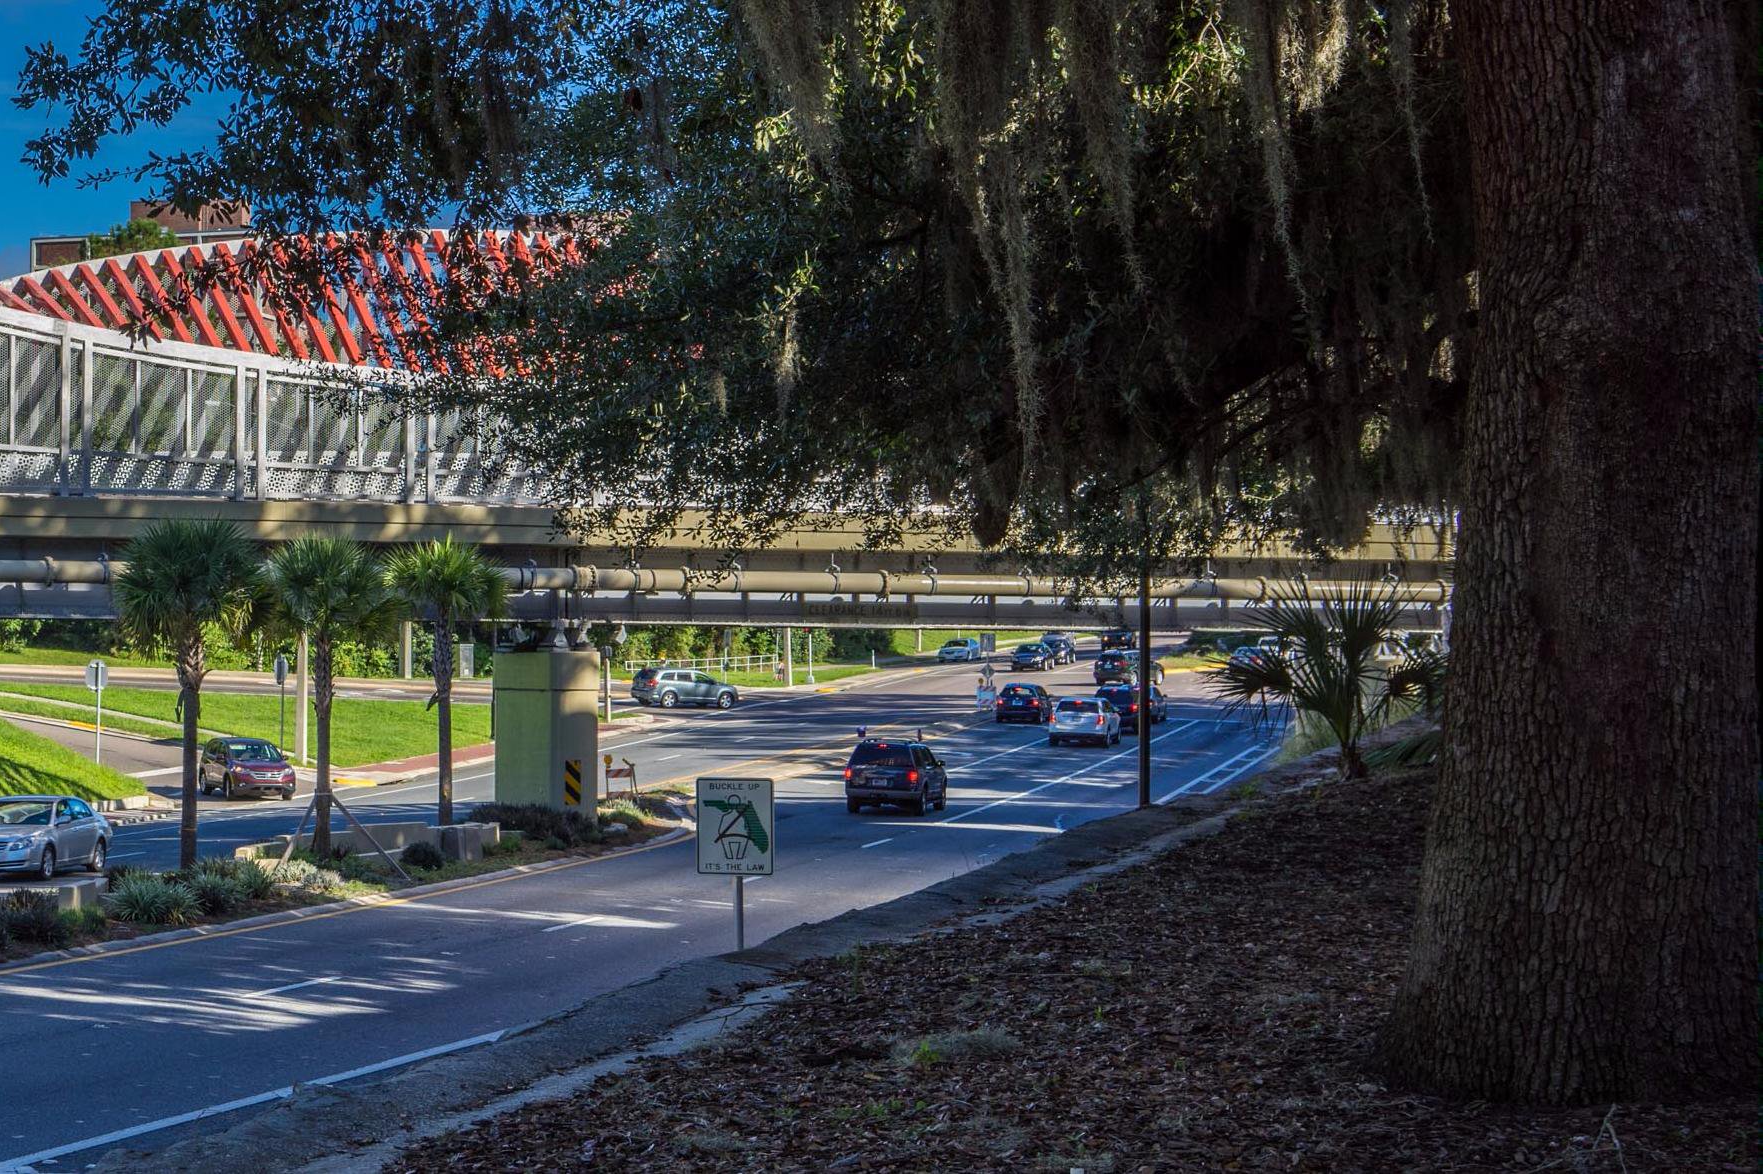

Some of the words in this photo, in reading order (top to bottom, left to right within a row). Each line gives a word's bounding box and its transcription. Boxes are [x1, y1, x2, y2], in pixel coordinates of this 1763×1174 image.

[809, 604, 867, 616] CLEARANCE
[709, 782, 743, 791] BUCKLE
[748, 783, 761, 791] UP
